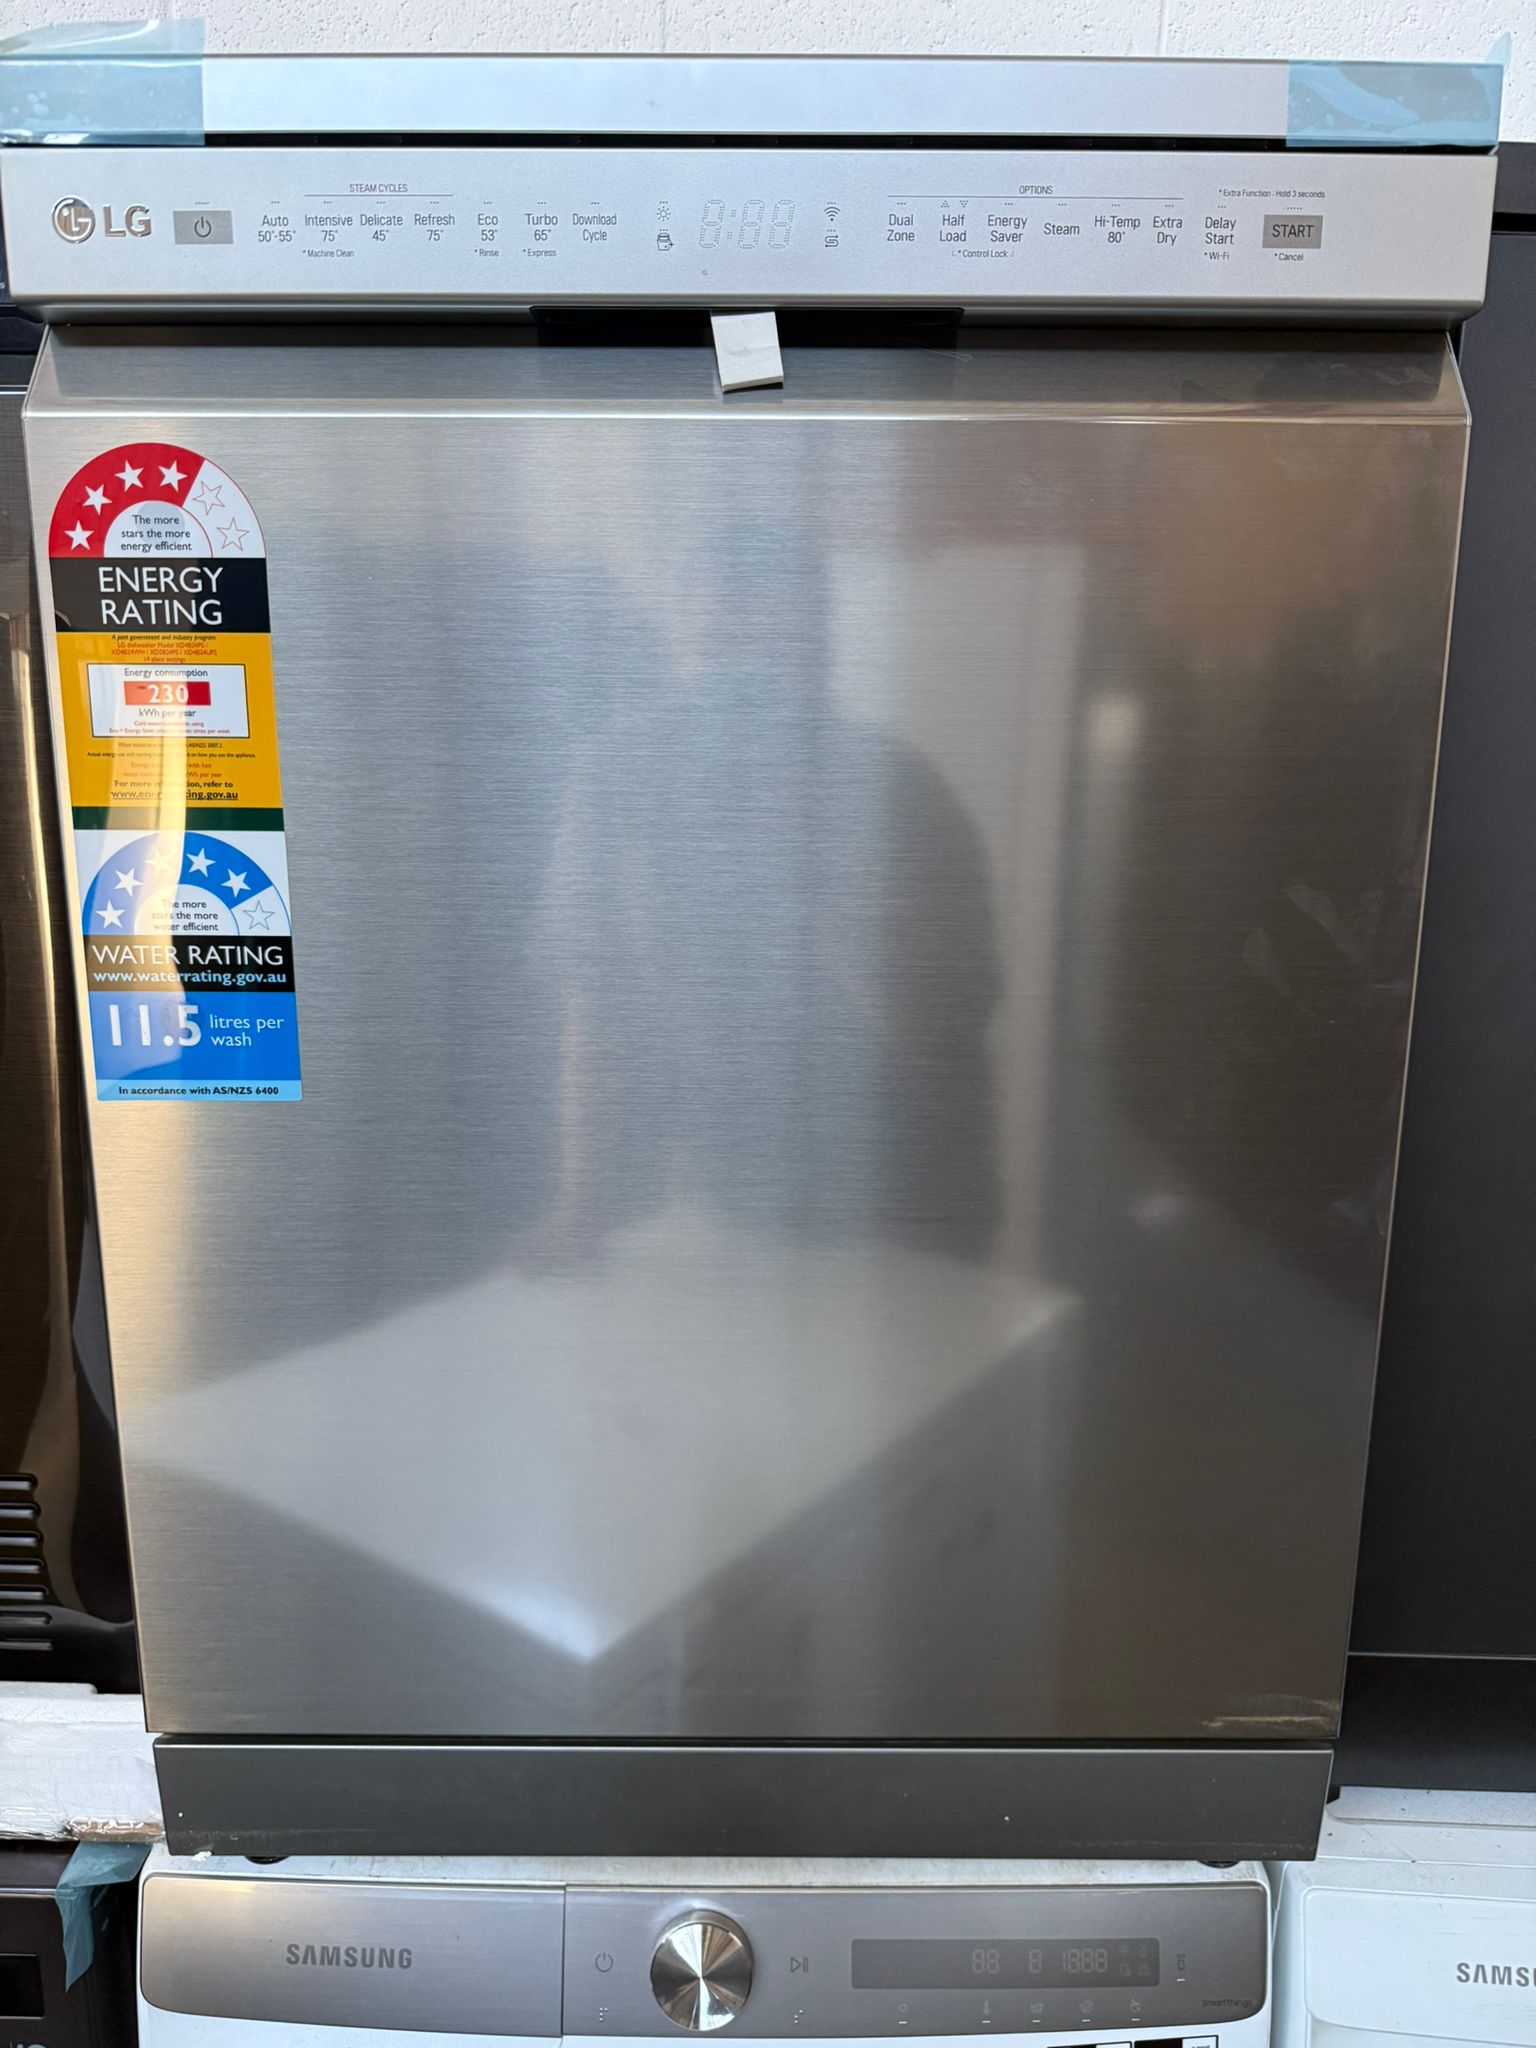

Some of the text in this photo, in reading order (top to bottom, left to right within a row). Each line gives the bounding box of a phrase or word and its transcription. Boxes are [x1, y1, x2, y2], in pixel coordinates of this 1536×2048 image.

[349, 184, 408, 193] STEAM CYCLES
[1019, 185, 1053, 195] OPTIONS
[1242, 190, 1271, 198] Function
[103, 204, 152, 238] LG
[262, 214, 289, 227] Auto
[304, 214, 353, 227] Intensive
[360, 214, 403, 227] Delicate
[414, 214, 455, 227] Refresh
[477, 214, 499, 227] Eco
[525, 214, 558, 227] Turbo
[573, 214, 617, 227] Download
[888, 214, 914, 227] Dual
[942, 214, 966, 227] Half
[987, 214, 1028, 231] Energy
[1094, 216, 1141, 231] Hi-Temp
[1153, 216, 1184, 229] Extra
[1205, 217, 1237, 232] Delay
[886, 229, 915, 242] Zone
[939, 229, 967, 242] Load
[1043, 222, 1080, 236] Steam
[1272, 224, 1314, 239] START
[582, 229, 608, 243] Cycle
[990, 230, 1023, 243] Saver
[1157, 231, 1177, 246] Dry
[1205, 231, 1235, 245] Start
[307, 249, 354, 258] Machine Clean
[479, 249, 500, 258] Rinse
[527, 249, 557, 259] Express
[963, 249, 1008, 258] Control Lock
[1209, 251, 1230, 260] Wi-Fi
[1279, 252, 1304, 262] Cancel
[132, 514, 180, 525] The more
[121, 528, 191, 538] stars the more
[120, 540, 192, 553] energy efficient
[98, 566, 224, 593] ENERGY
[101, 598, 222, 626] RATING
[124, 667, 208, 678] Energy consumption
[147, 684, 189, 703] 230
[138, 708, 196, 719] kWh per year
[162, 899, 207, 909] The more
[151, 911, 219, 920] stars the more
[153, 922, 219, 932] water efficient
[92, 945, 284, 966] WATER RATING
[93, 969, 287, 986] www.waterrating.gov.au
[109, 1003, 202, 1047] 11.5
[210, 1014, 285, 1033] litres per
[210, 1031, 252, 1047] wash
[118, 1086, 279, 1095] In accordance with AS/NZS 6400
[286, 1943, 413, 1970] SAMSUNG
[1456, 1962, 1536, 1988] SAMS
